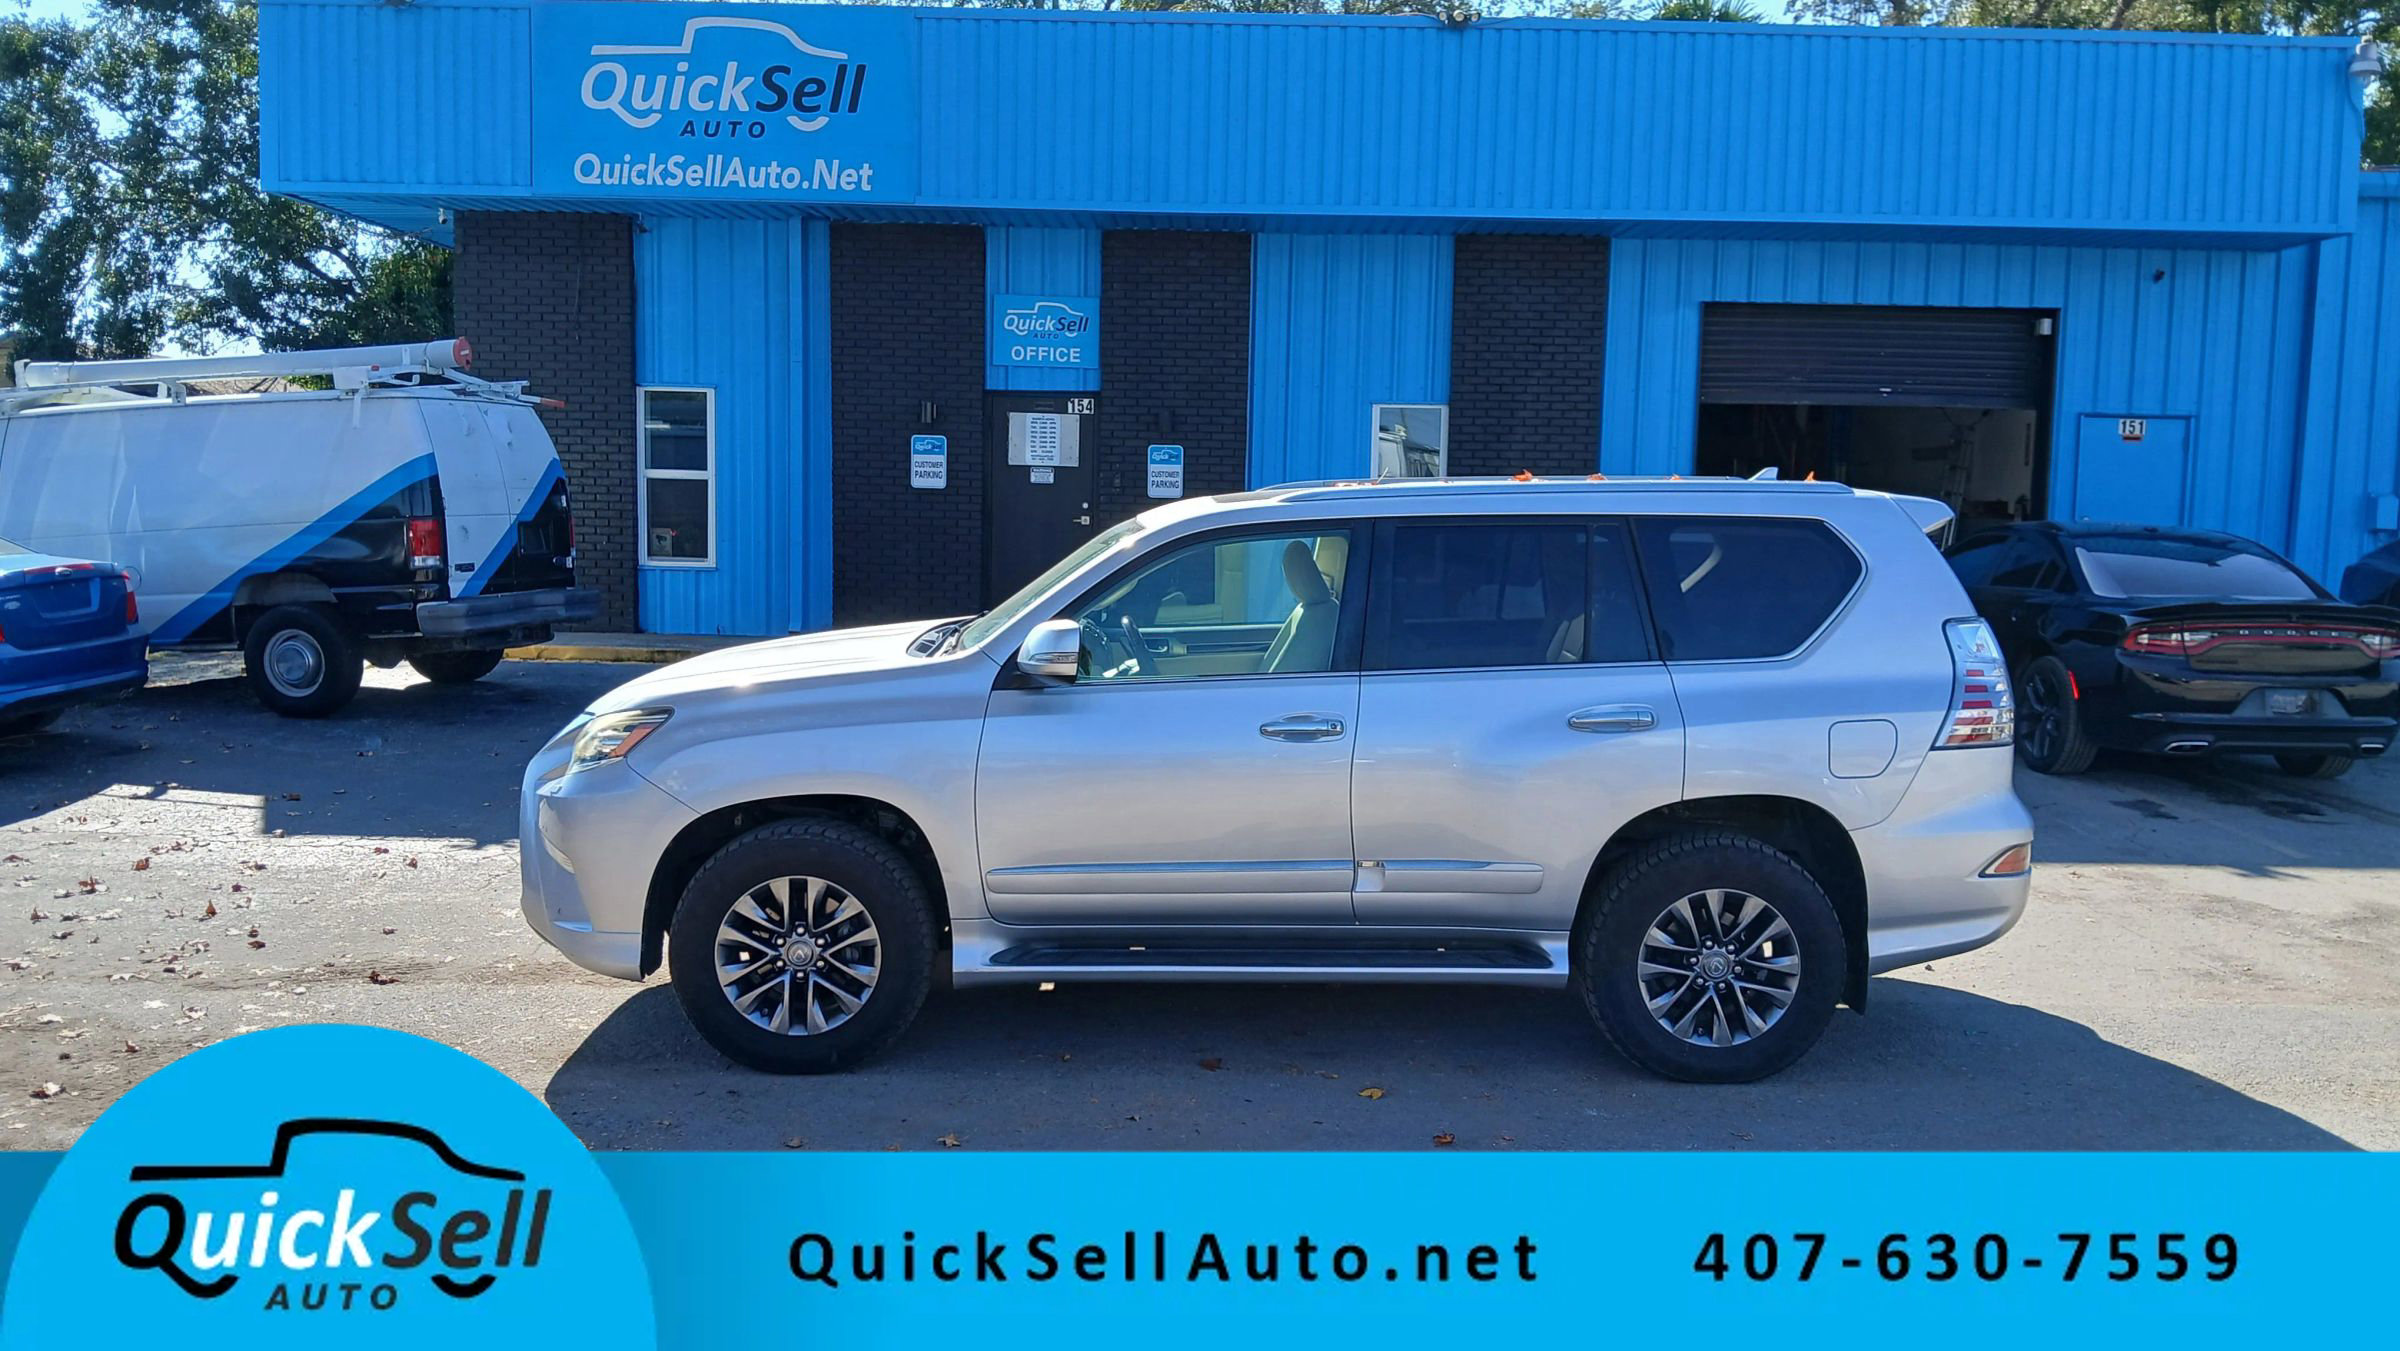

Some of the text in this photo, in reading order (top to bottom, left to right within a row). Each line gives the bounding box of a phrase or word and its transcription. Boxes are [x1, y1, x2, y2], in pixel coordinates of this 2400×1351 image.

[580, 61, 867, 129] QuickSell
[680, 120, 766, 138] AUTO
[574, 153, 873, 191] QuickSellAuto.Net
[1004, 314, 1089, 336] QuickSell
[1011, 345, 1081, 362] OFFICE
[1070, 399, 1094, 414] 154
[2121, 420, 2145, 435] 151
[914, 461, 944, 469] CUSTOMER
[914, 470, 943, 480] PARKING
[1151, 479, 1180, 489] PARKING
